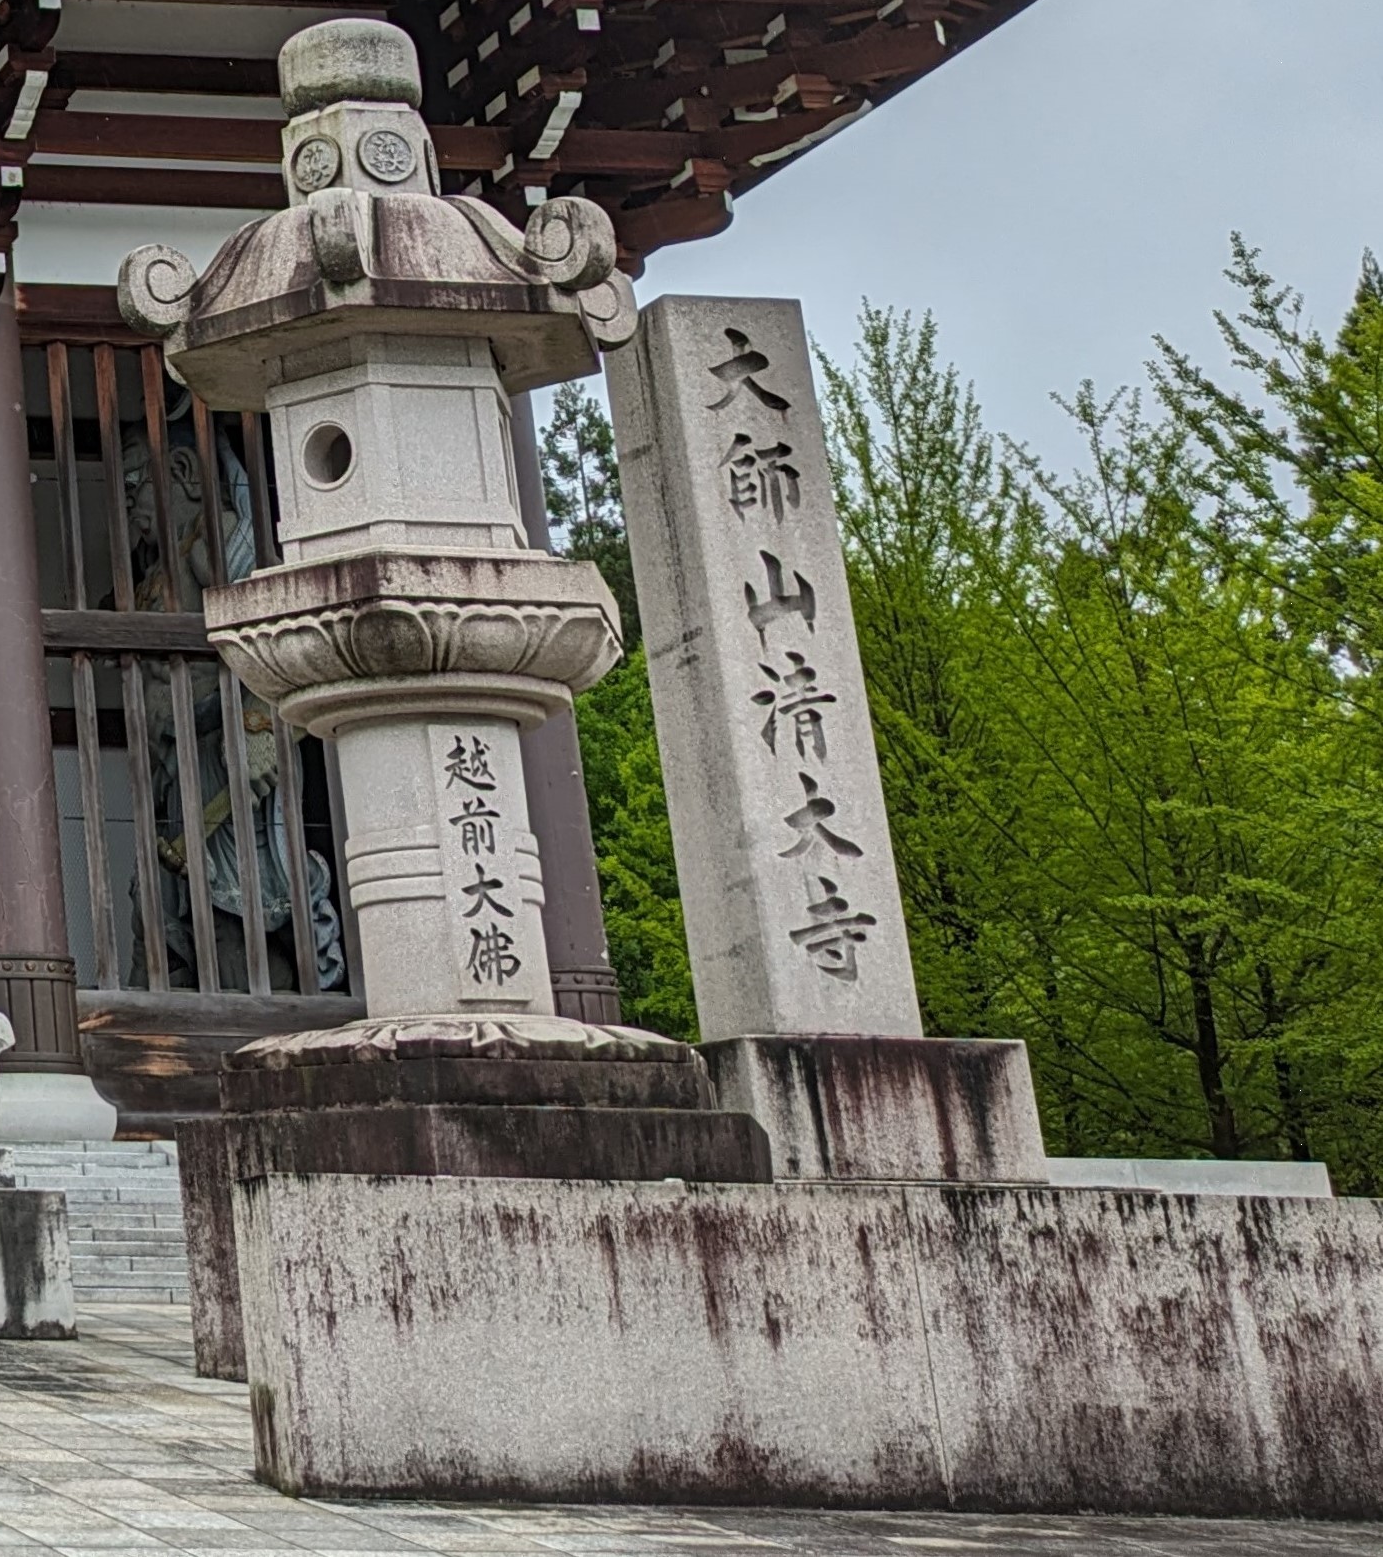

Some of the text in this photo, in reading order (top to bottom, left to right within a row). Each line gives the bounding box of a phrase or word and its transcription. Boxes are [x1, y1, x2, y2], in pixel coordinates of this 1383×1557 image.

[444, 735, 522, 986] 越前大佛
[706, 327, 878, 984] 大師山清大寺
